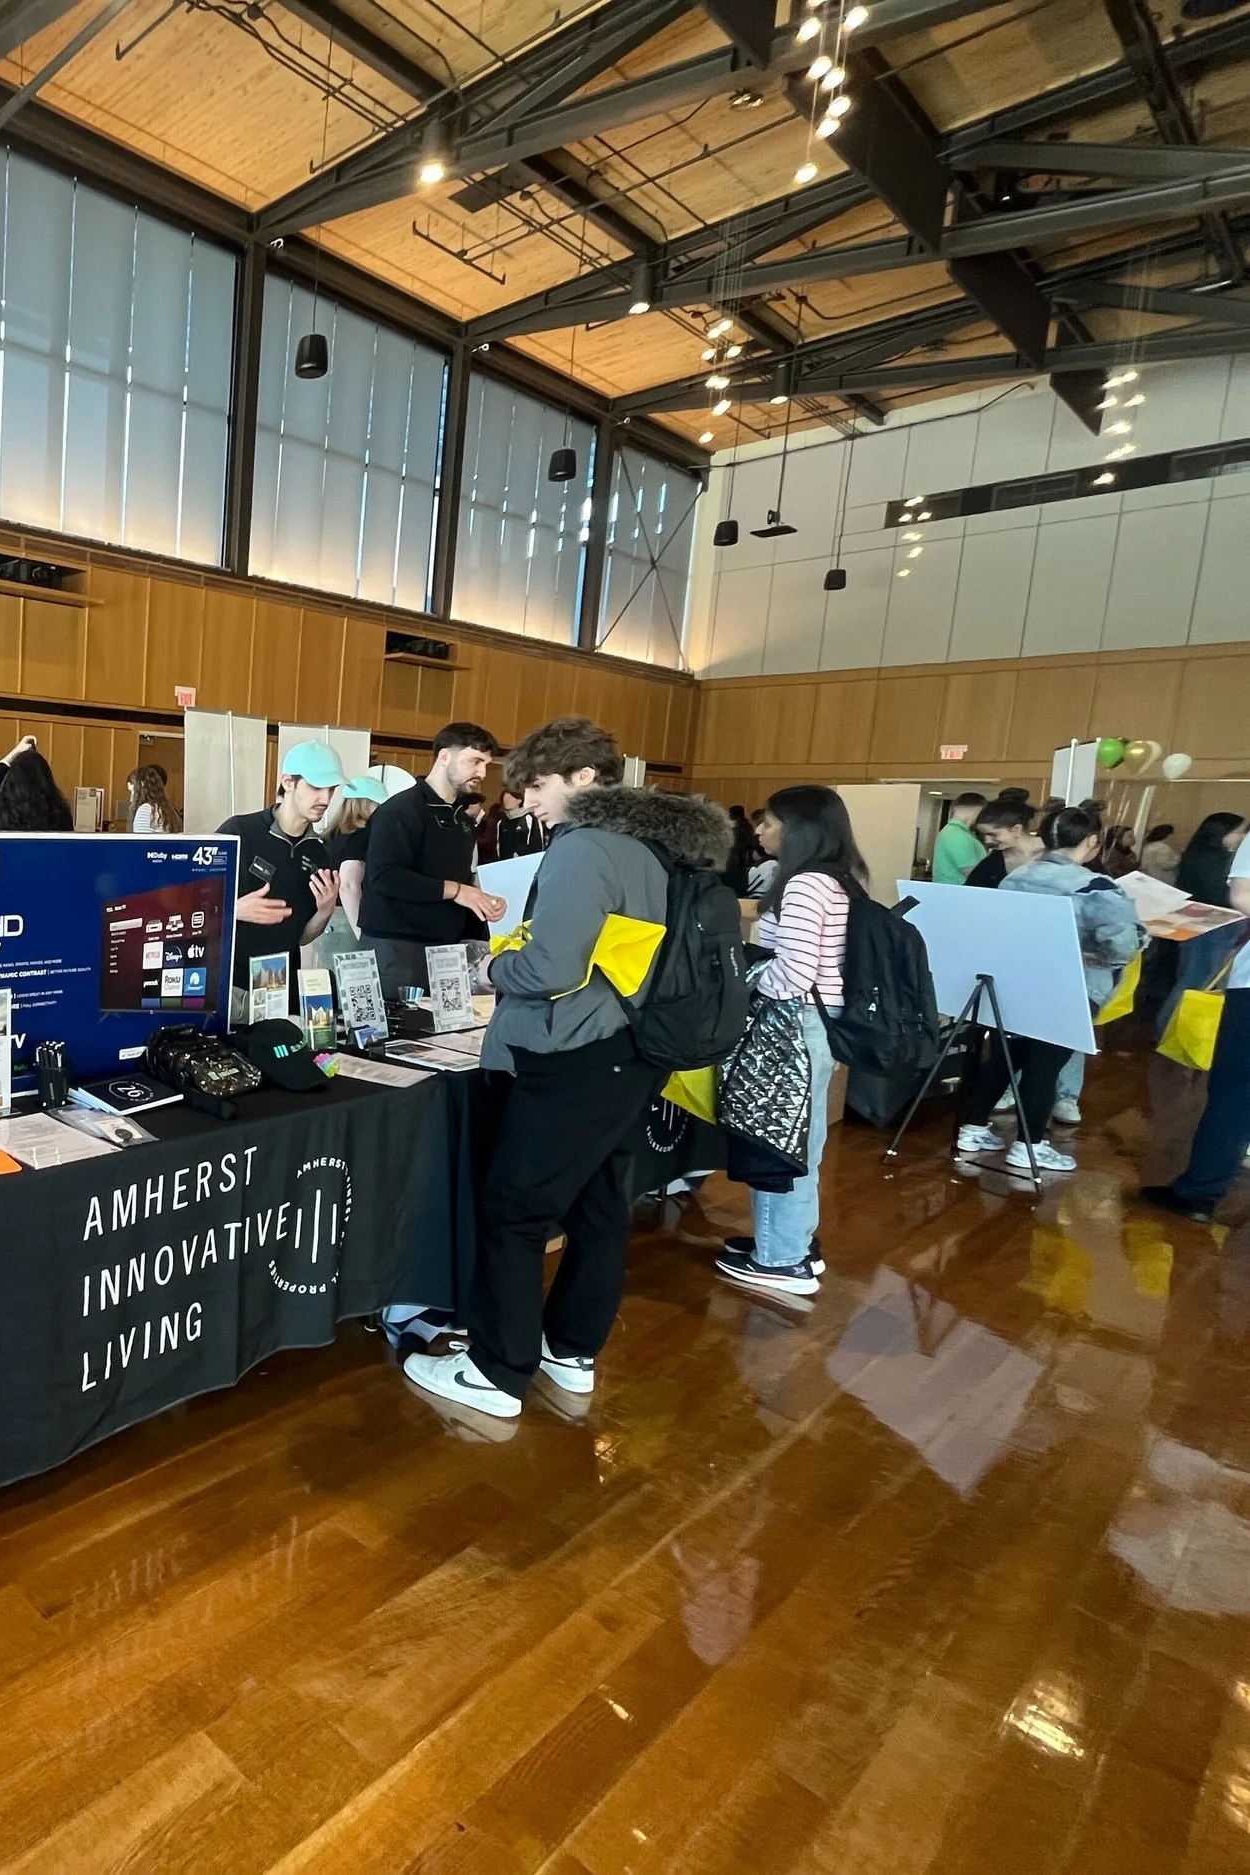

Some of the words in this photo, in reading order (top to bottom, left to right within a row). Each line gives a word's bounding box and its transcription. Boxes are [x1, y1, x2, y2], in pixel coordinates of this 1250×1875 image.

[192, 846, 218, 866] 43"
[18, 969, 47, 978] CONTRAST
[83, 1146, 258, 1241] AMHERST
[82, 1201, 291, 1317] INNOVATIVE
[268, 1259, 327, 1294] PROPERTIES
[81, 1302, 203, 1393] LIVING
